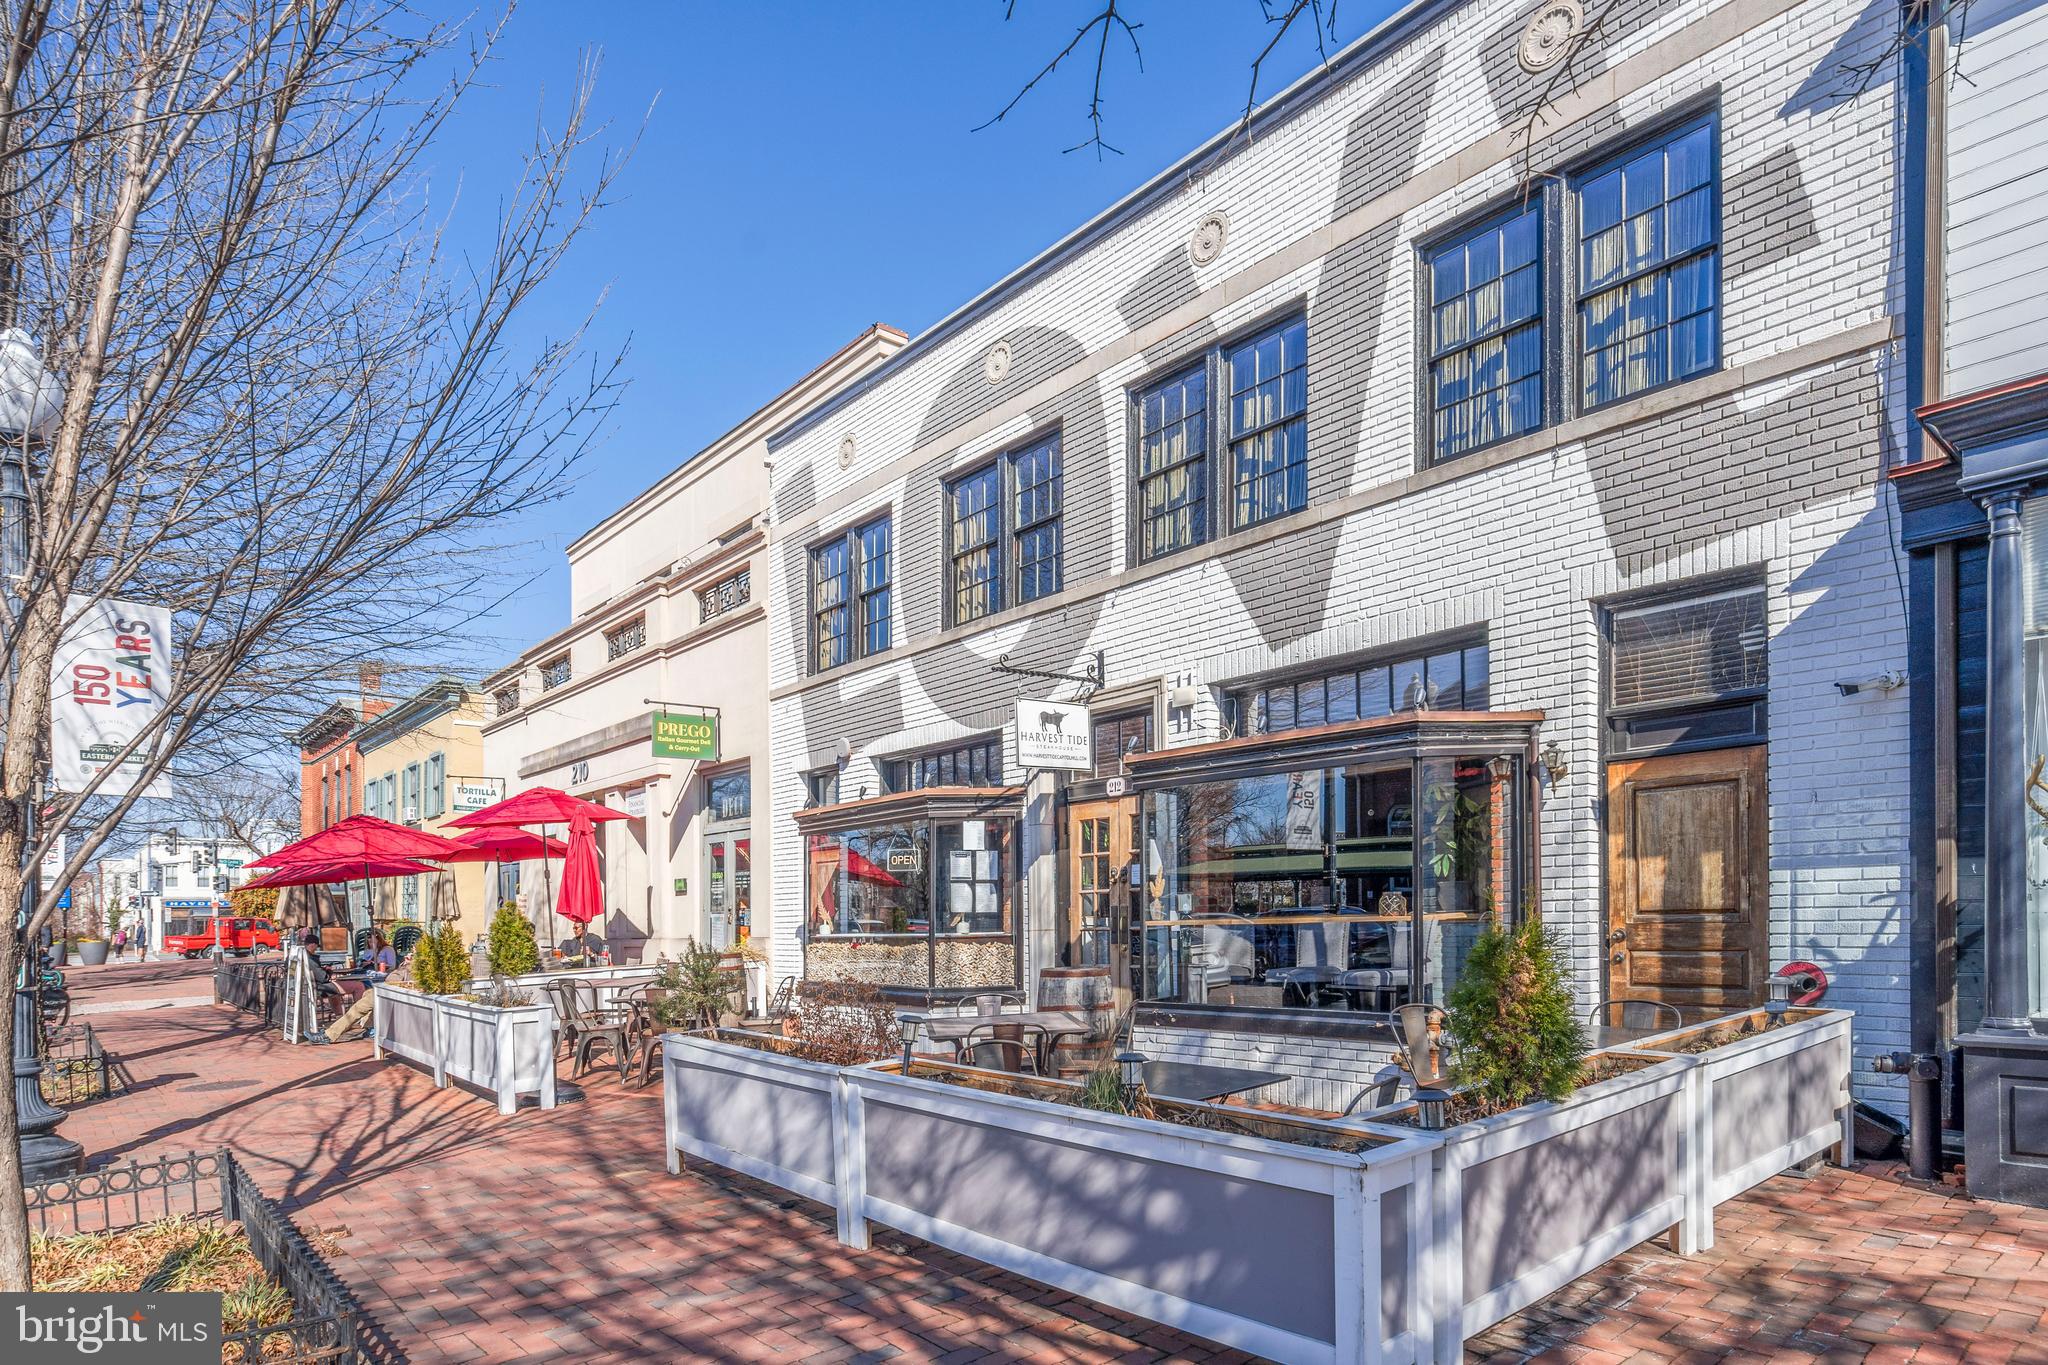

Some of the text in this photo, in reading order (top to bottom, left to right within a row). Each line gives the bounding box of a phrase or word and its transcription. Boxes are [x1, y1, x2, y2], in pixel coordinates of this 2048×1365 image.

[115, 618, 152, 709] YEARS
[73, 664, 111, 706] 150
[657, 721, 711, 738] PREGO
[676, 737, 700, 745] Gourmet
[1020, 731, 1088, 746] HARVEST TIDE
[674, 744, 700, 753] Carry-Out
[571, 761, 590, 786] 210
[456, 786, 497, 797] TORTILLA
[1108, 781, 1122, 793] 212
[466, 797, 487, 805] CAFE
[891, 855, 917, 865] OPEN
